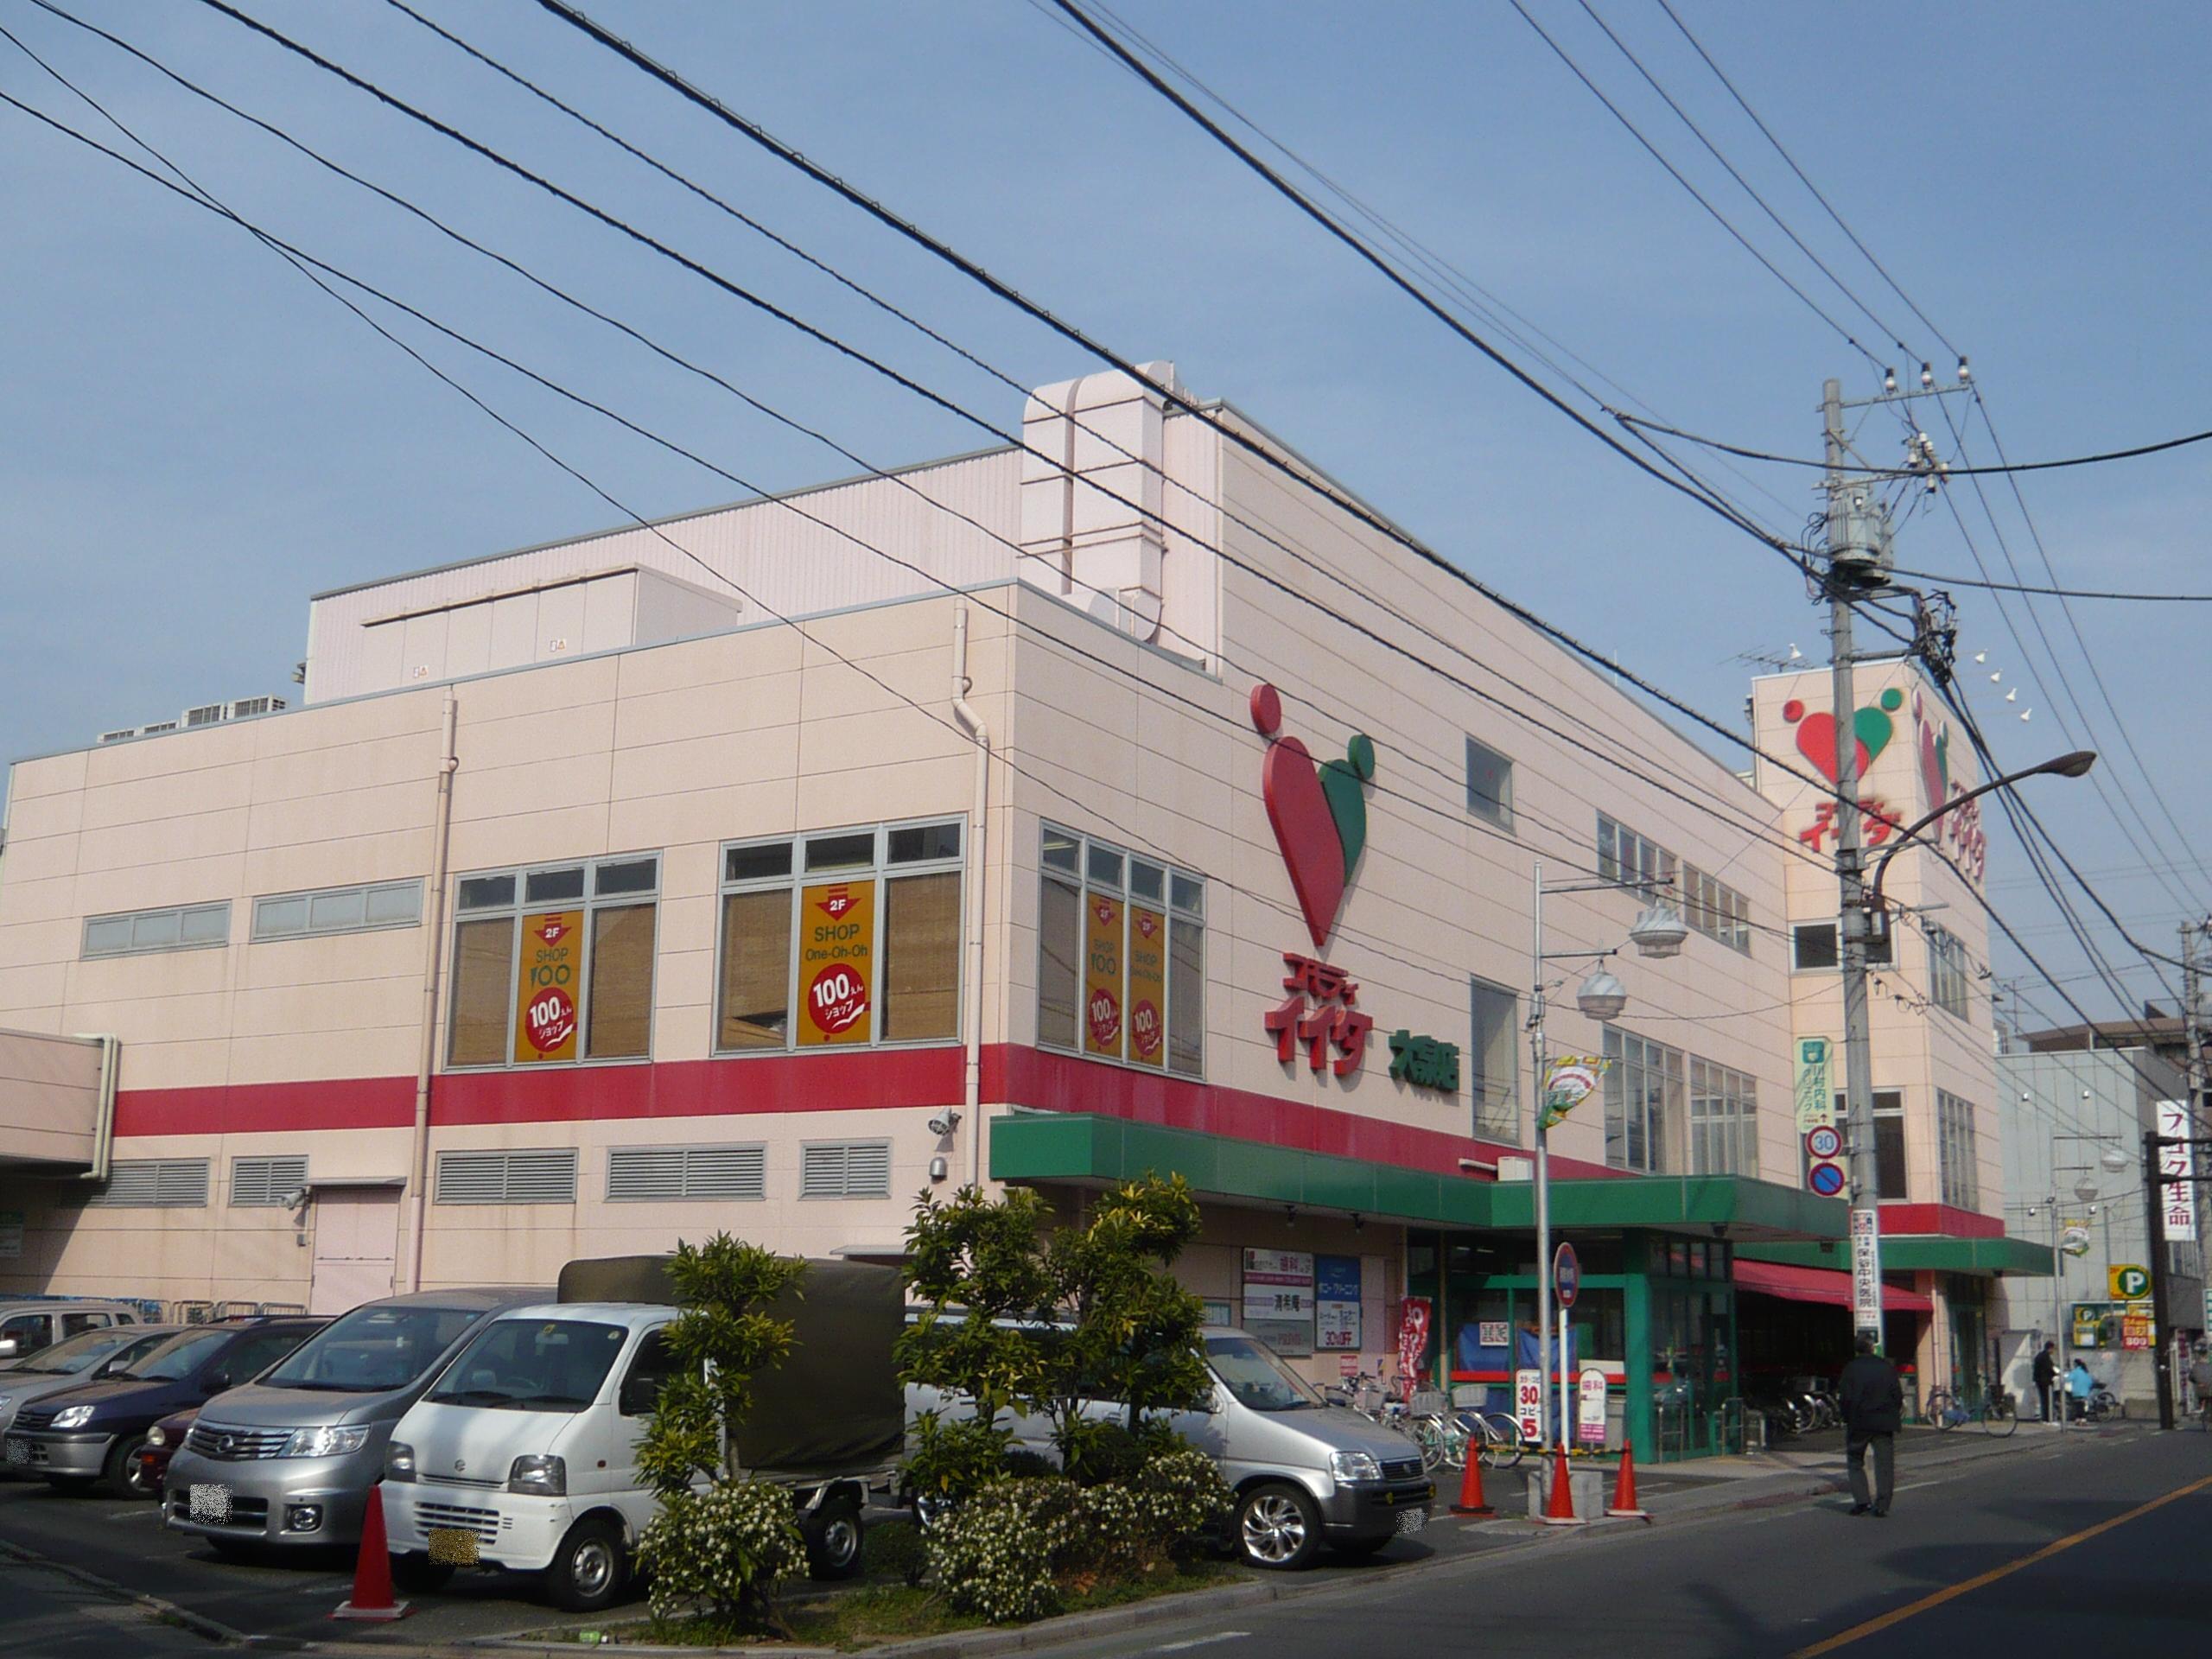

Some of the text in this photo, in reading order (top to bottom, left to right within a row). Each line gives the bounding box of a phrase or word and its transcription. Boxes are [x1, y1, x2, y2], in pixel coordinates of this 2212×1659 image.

[1815, 798, 1885, 822] コディ
[829, 899, 847, 912] 2F
[544, 927, 560, 938] 2F
[815, 924, 861, 943] SHOP
[536, 947, 569, 963] SHOP
[805, 944, 868, 962] One-Oh-Oh
[1282, 952, 1359, 1005] コモディ
[825, 999, 855, 1020] ショップ
[538, 1020, 564, 1039] ショップ
[1264, 996, 1374, 1077] イイダ
[1815, 1135, 1834, 1151] 30
[2163, 1112, 2190, 1226] フコク生命
[2126, 1272, 2145, 1294] P
[1520, 1385, 1538, 1405] 30
[1522, 1418, 1537, 1438] 5
